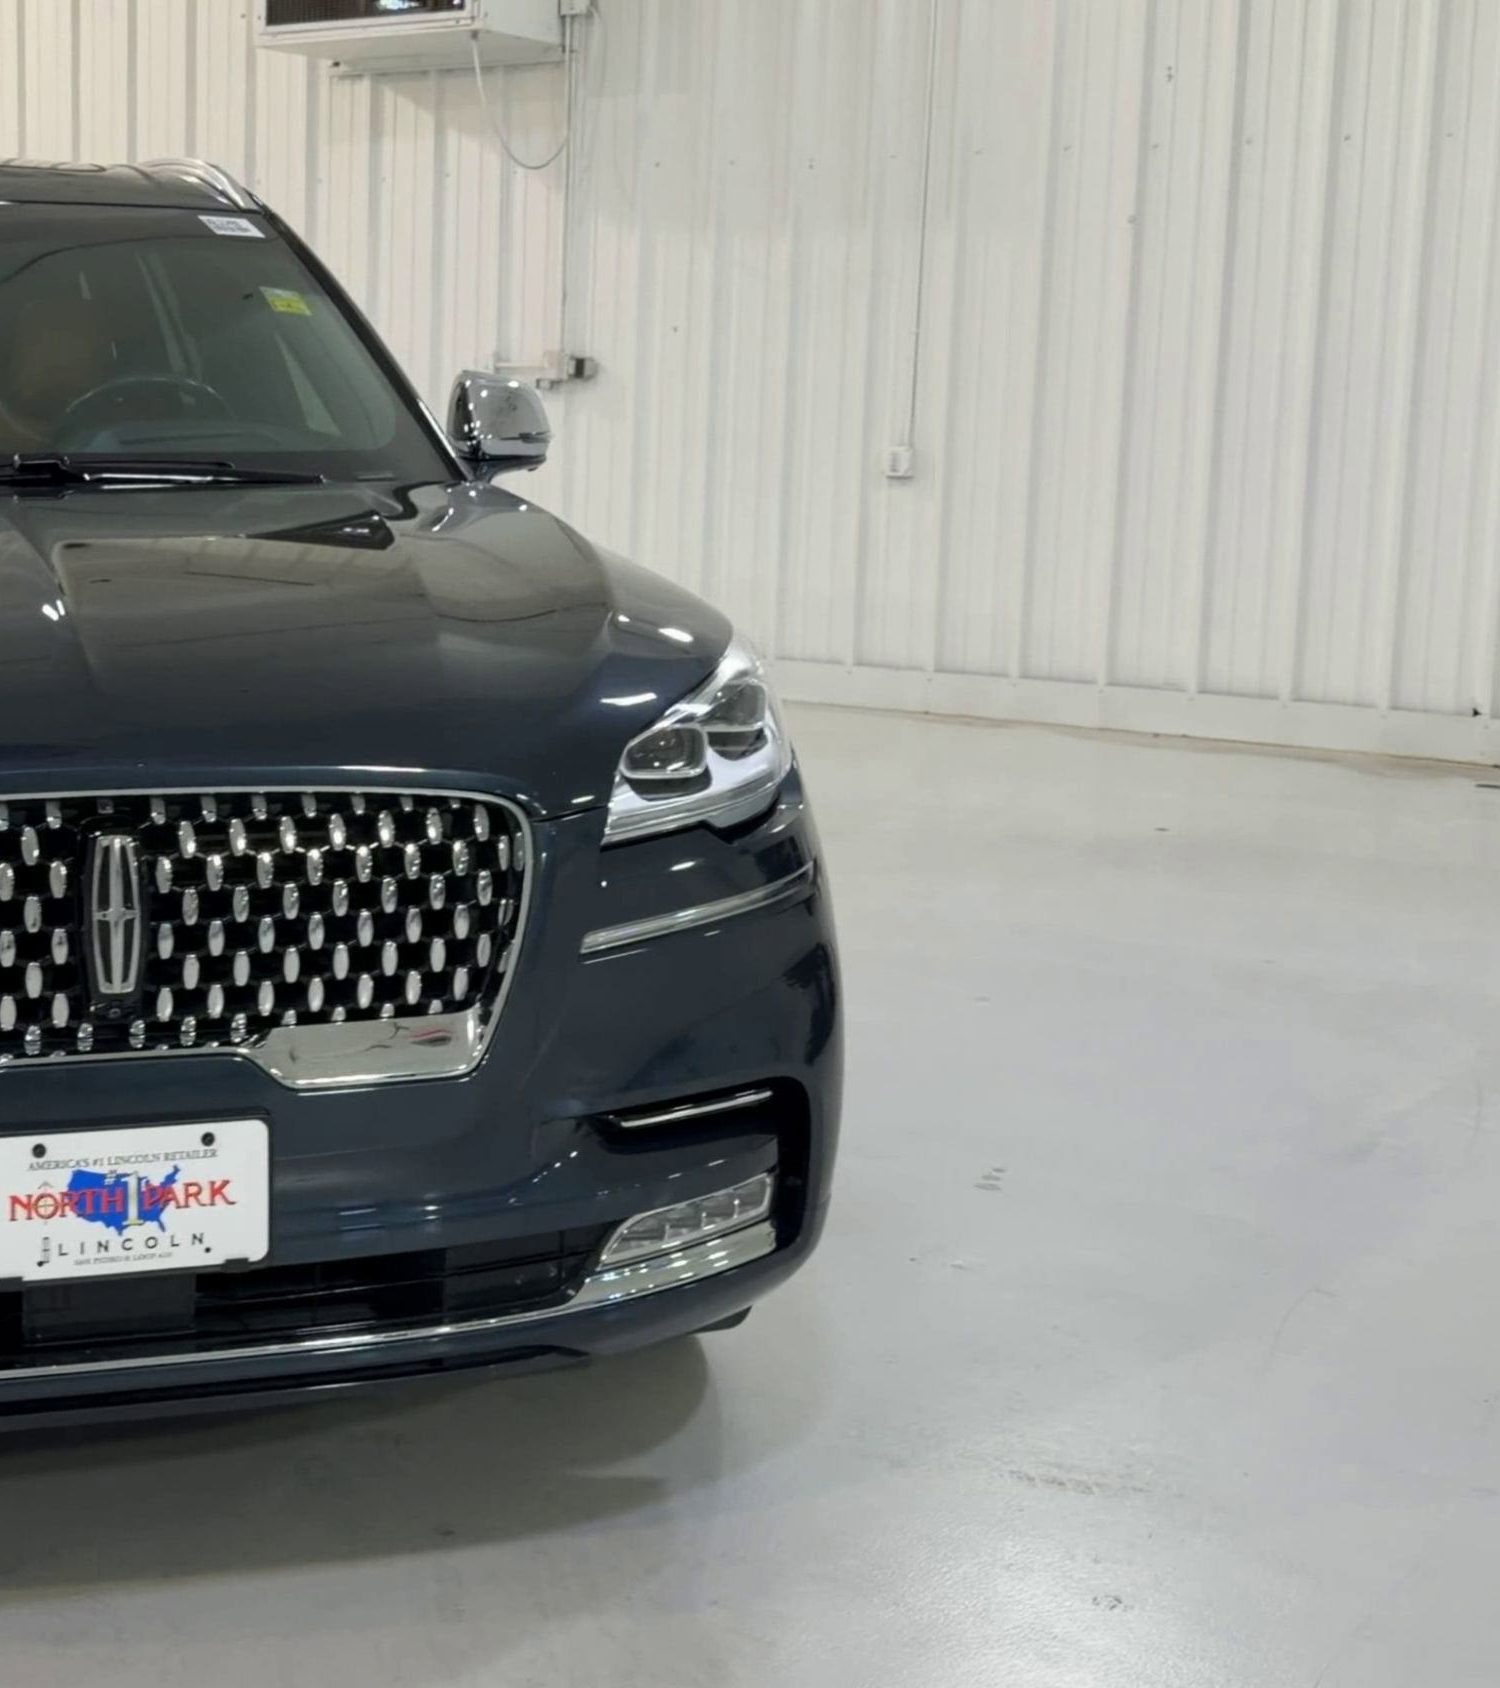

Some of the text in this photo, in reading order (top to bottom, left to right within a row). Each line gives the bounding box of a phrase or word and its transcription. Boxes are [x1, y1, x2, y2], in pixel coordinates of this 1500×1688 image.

[107, 1152, 161, 1166] LINCOLN
[163, 1149, 218, 1162] RETAILER
[9, 1180, 237, 1221] NORTH PARK
[58, 1233, 204, 1256] LINCOLN
